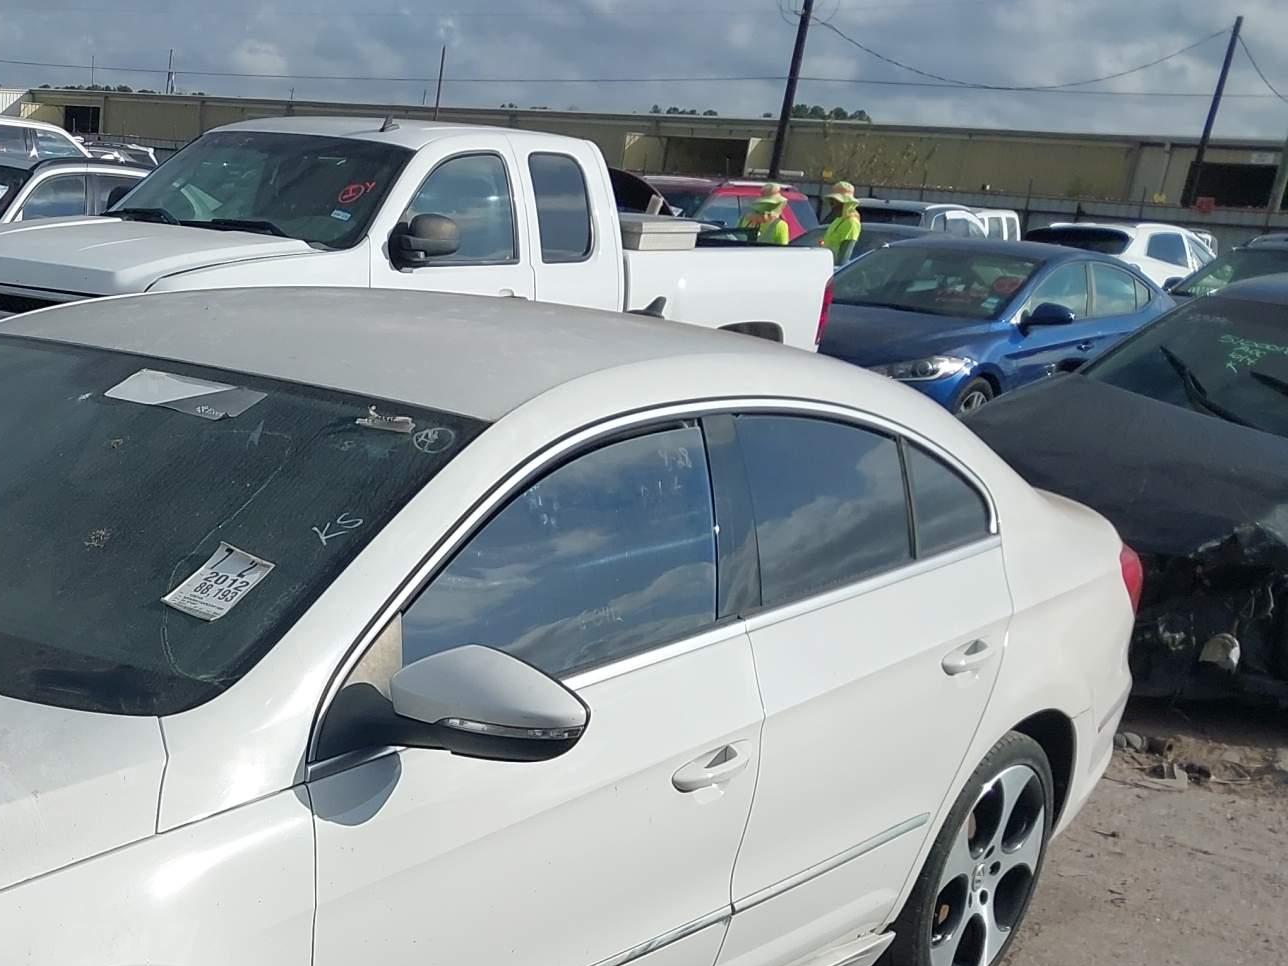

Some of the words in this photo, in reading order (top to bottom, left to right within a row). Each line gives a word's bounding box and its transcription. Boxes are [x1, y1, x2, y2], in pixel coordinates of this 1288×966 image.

[311, 512, 364, 546] KS
[193, 582, 239, 602] 88,193
[203, 571, 250, 592] 2012
